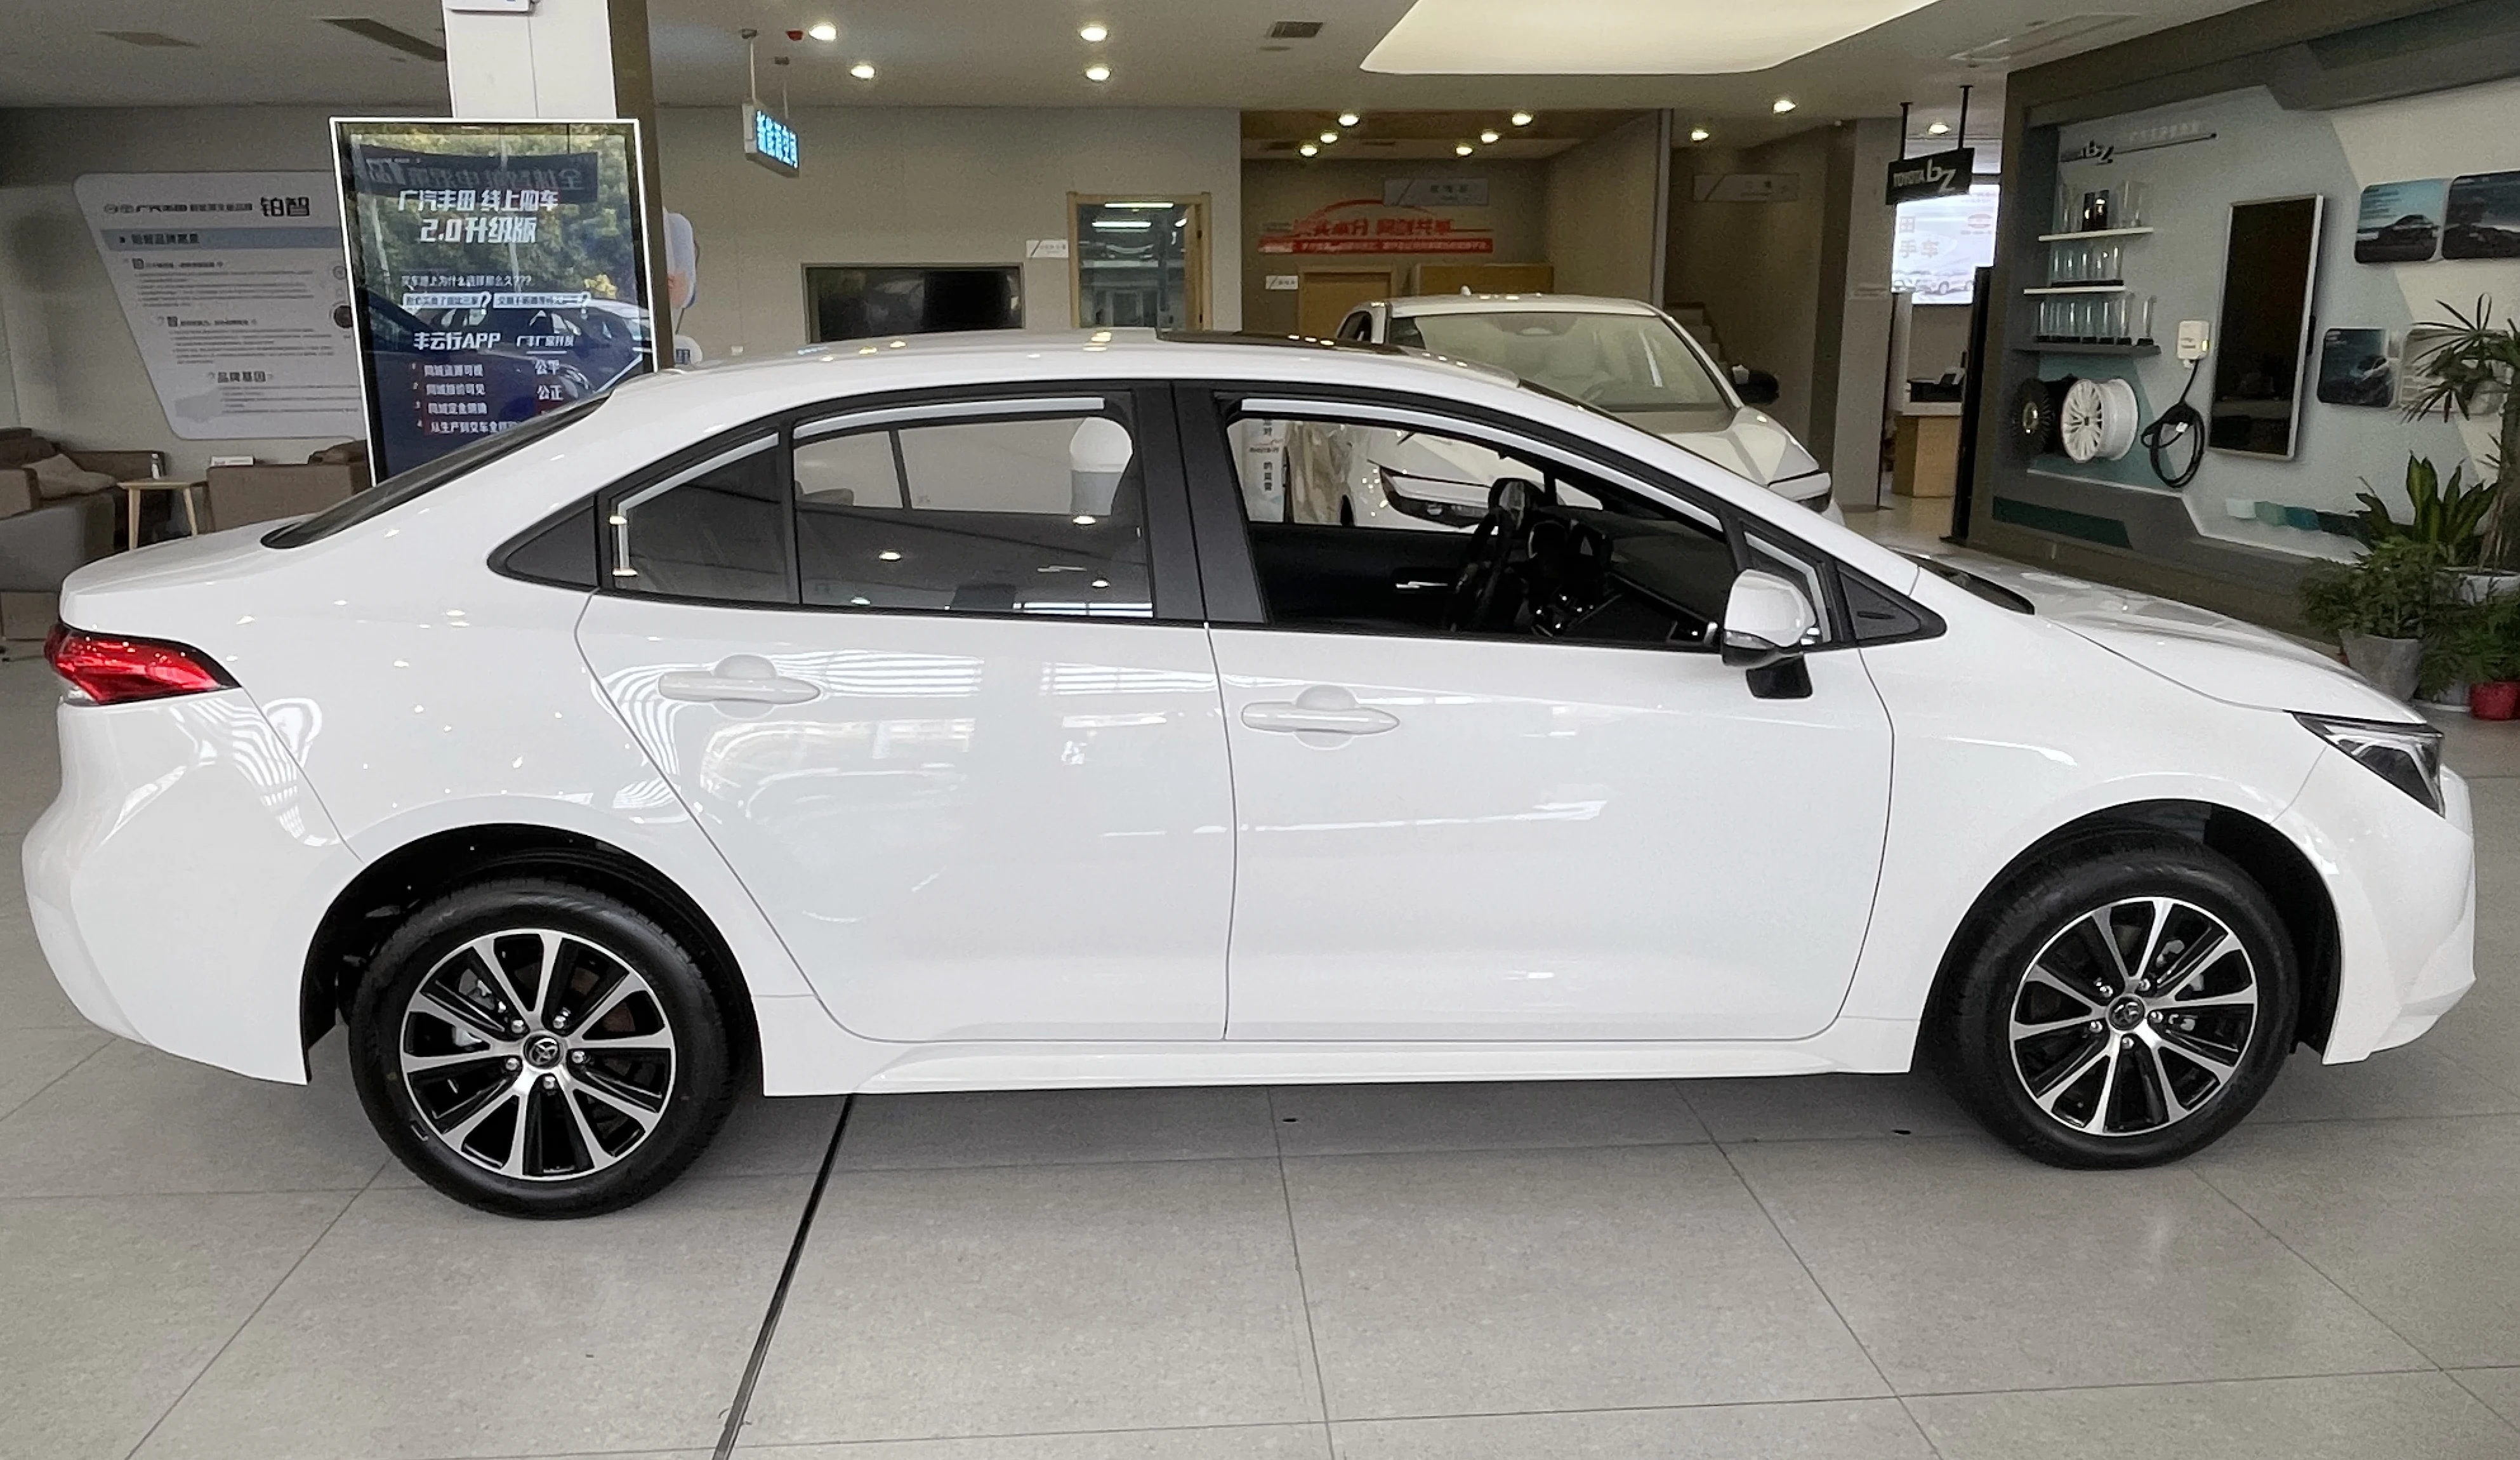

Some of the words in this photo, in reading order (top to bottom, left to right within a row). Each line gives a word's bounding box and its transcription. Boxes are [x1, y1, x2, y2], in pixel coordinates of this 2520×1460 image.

[260, 197, 310, 217] 铂智
[398, 190, 475, 211] 广汽丰田
[481, 189, 558, 212] 线上购车
[420, 217, 537, 243] 2.0升级版
[414, 331, 501, 350] 丰云行APP
[534, 359, 560, 375] 公平
[537, 385, 564, 401] 公正
